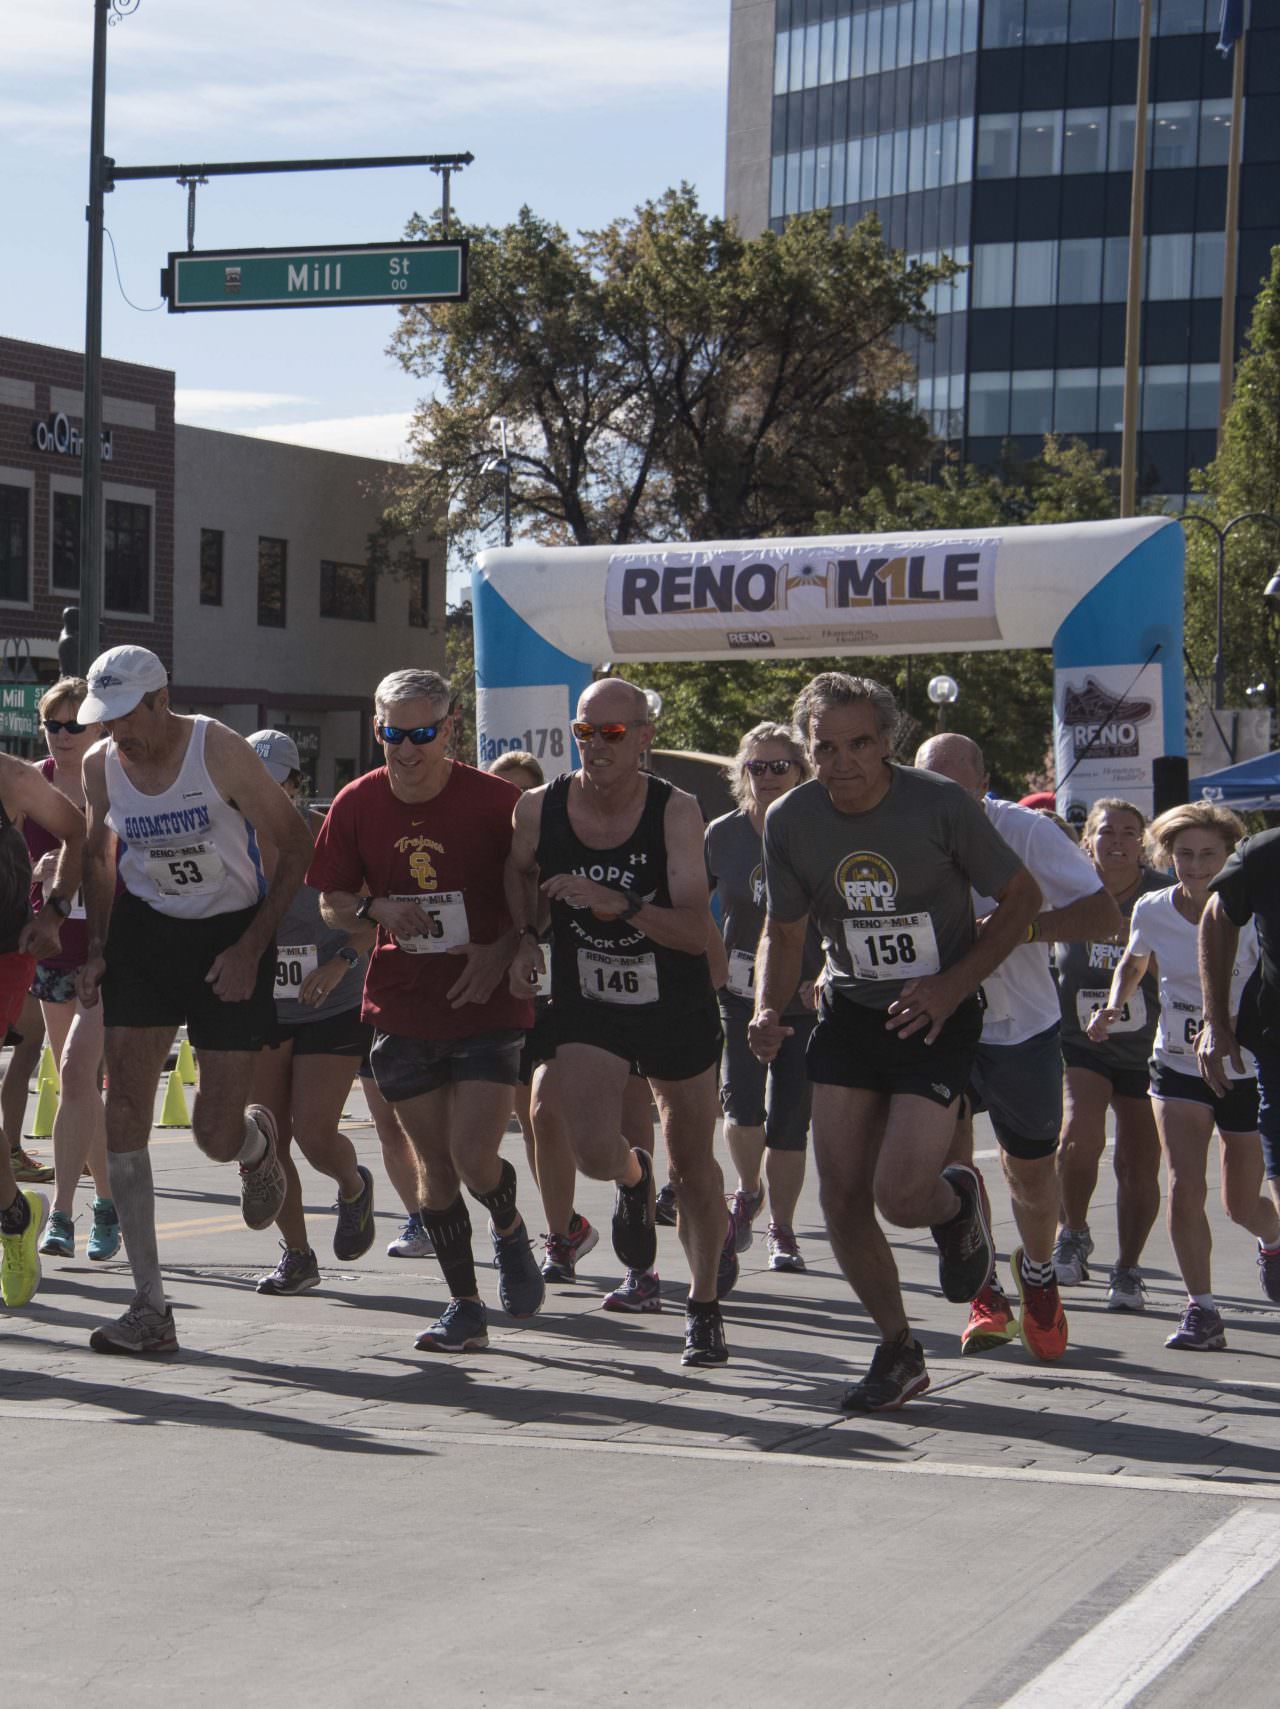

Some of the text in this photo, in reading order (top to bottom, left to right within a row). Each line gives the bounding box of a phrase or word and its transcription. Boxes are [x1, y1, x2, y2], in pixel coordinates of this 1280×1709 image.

[288, 257, 410, 291] Mill St
[391, 279, 408, 290] 00
[622, 563, 776, 616] RENO
[728, 631, 770, 643] RENO
[2, 688, 25, 708] Mill
[1074, 722, 1136, 746] RENO
[149, 849, 175, 859] RENO
[393, 835, 445, 854] Trojans
[168, 860, 204, 886] 53
[572, 864, 635, 889] HOPE
[845, 880, 893, 898] RENO
[569, 920, 646, 949] TRACK CLU
[852, 918, 881, 929] RENO
[586, 951, 612, 964] RENO
[864, 933, 917, 967] 158
[594, 968, 639, 993] 146
